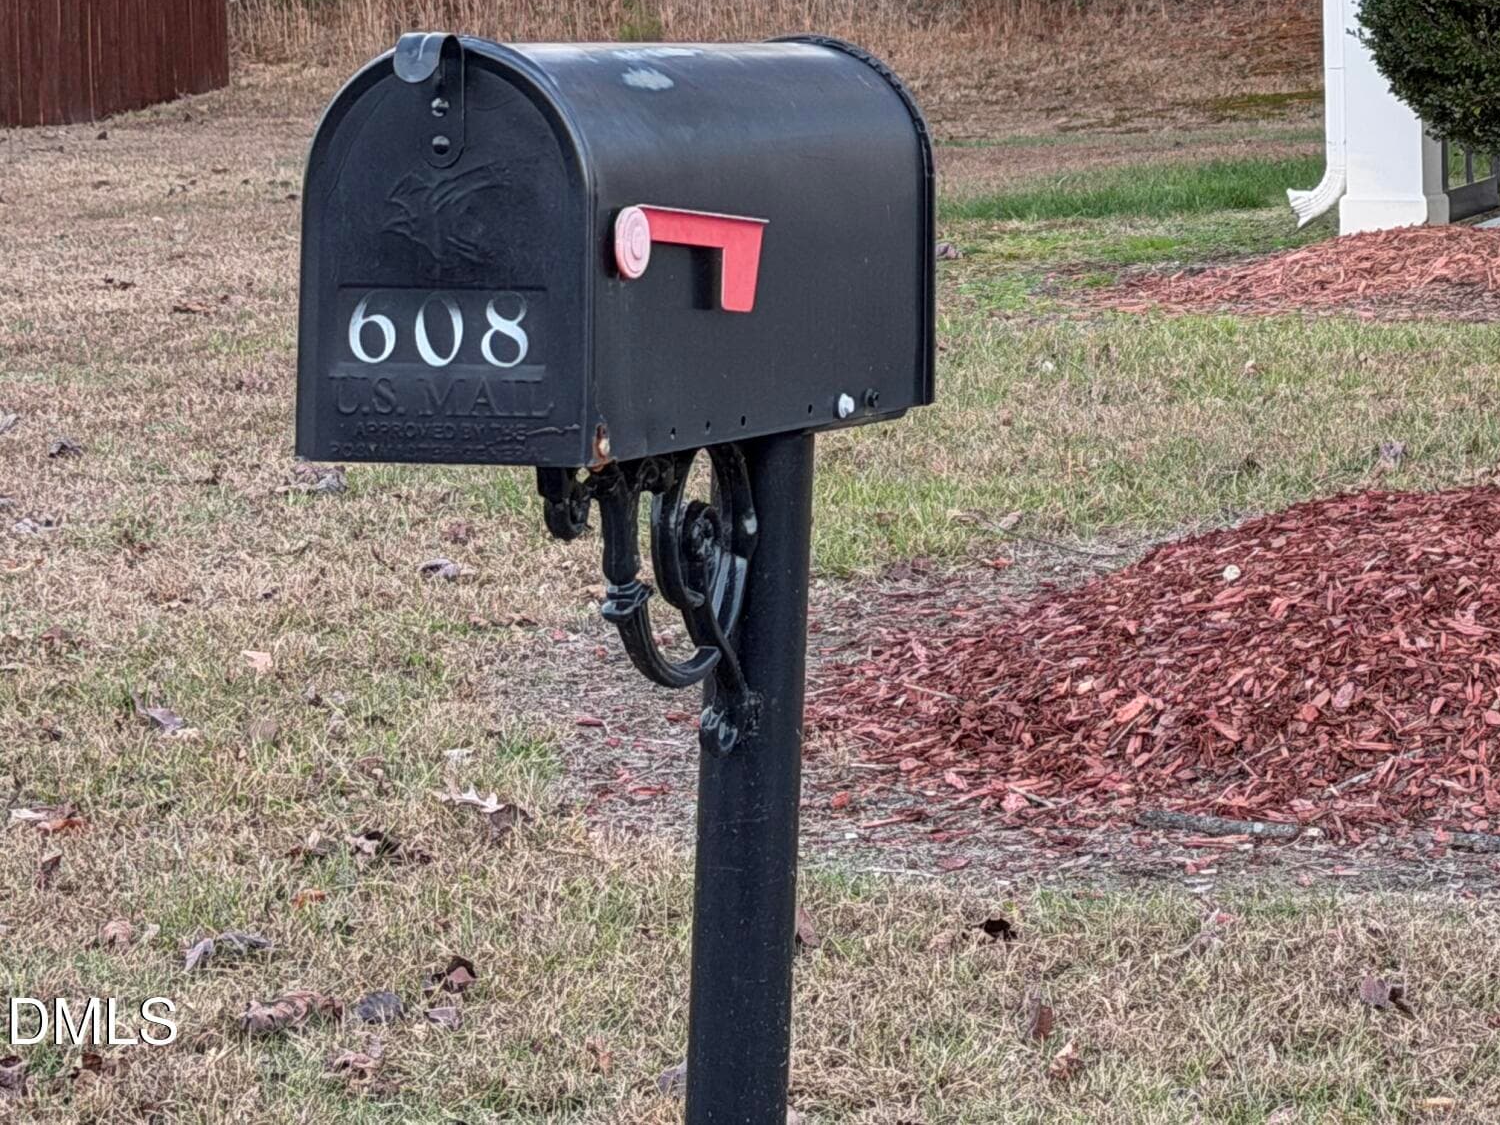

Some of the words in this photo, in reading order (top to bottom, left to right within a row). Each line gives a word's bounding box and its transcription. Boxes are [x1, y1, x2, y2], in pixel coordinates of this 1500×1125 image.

[348, 290, 529, 368] 608
[331, 377, 405, 416] U.S.
[416, 377, 555, 418] MAIL
